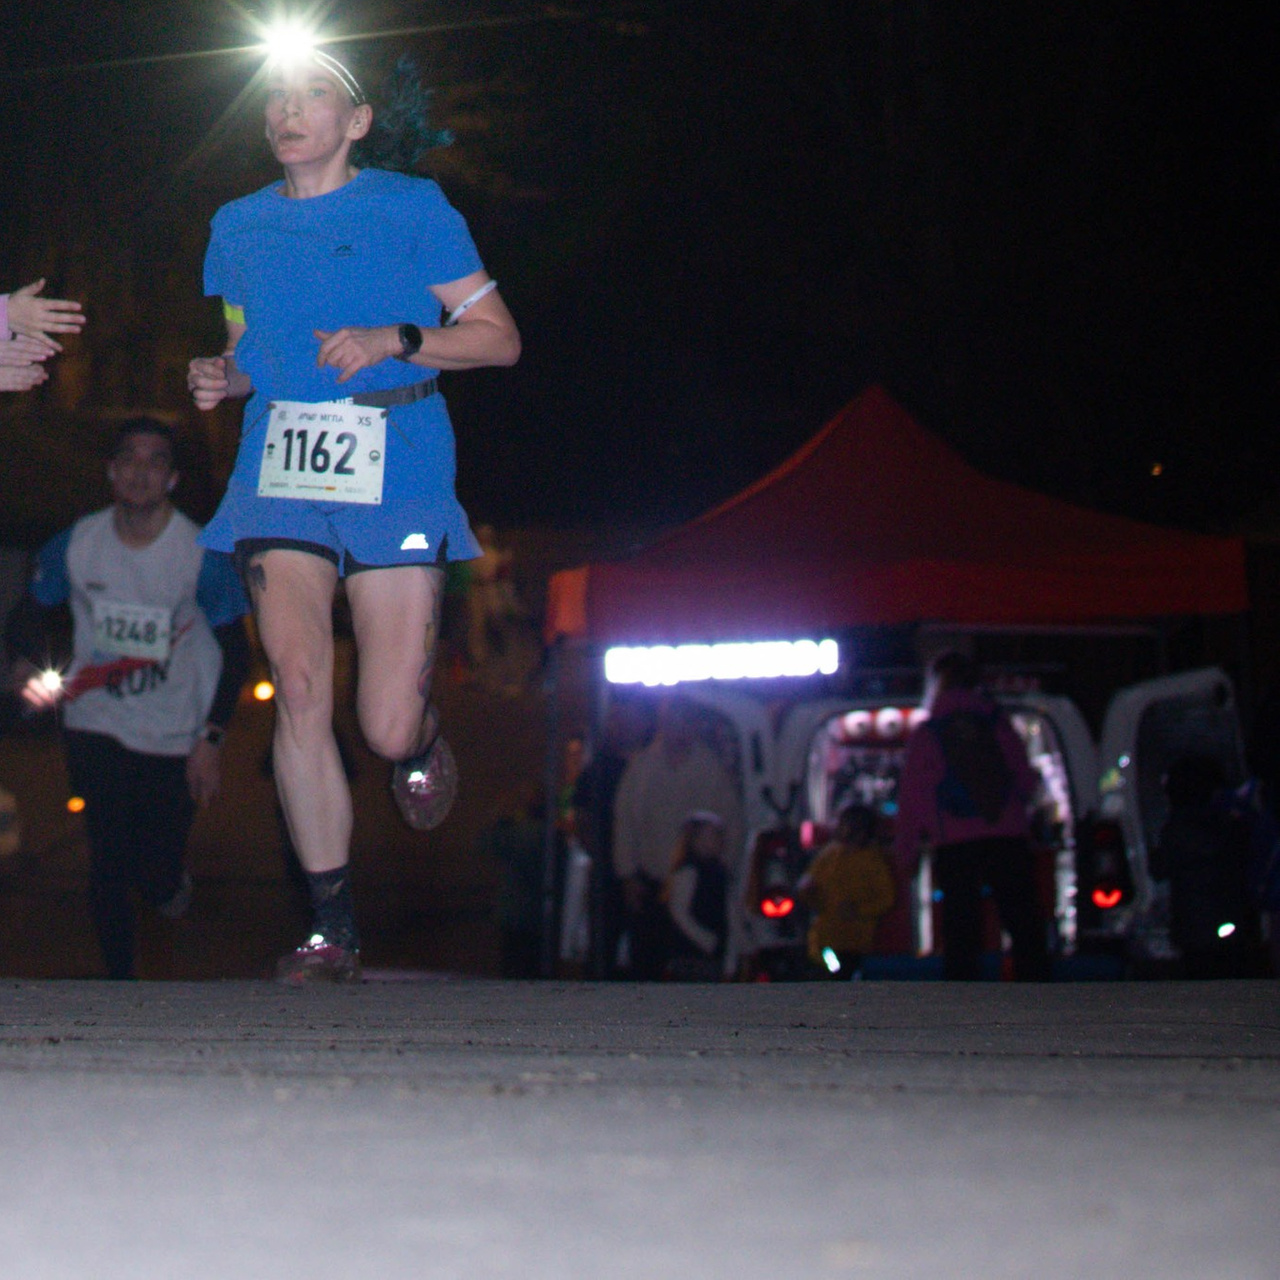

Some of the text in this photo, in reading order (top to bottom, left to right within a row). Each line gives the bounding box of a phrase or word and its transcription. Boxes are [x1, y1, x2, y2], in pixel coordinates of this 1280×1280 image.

[357, 415, 371, 426] XS
[283, 428, 357, 475] 1162
[104, 616, 157, 644] 1248
